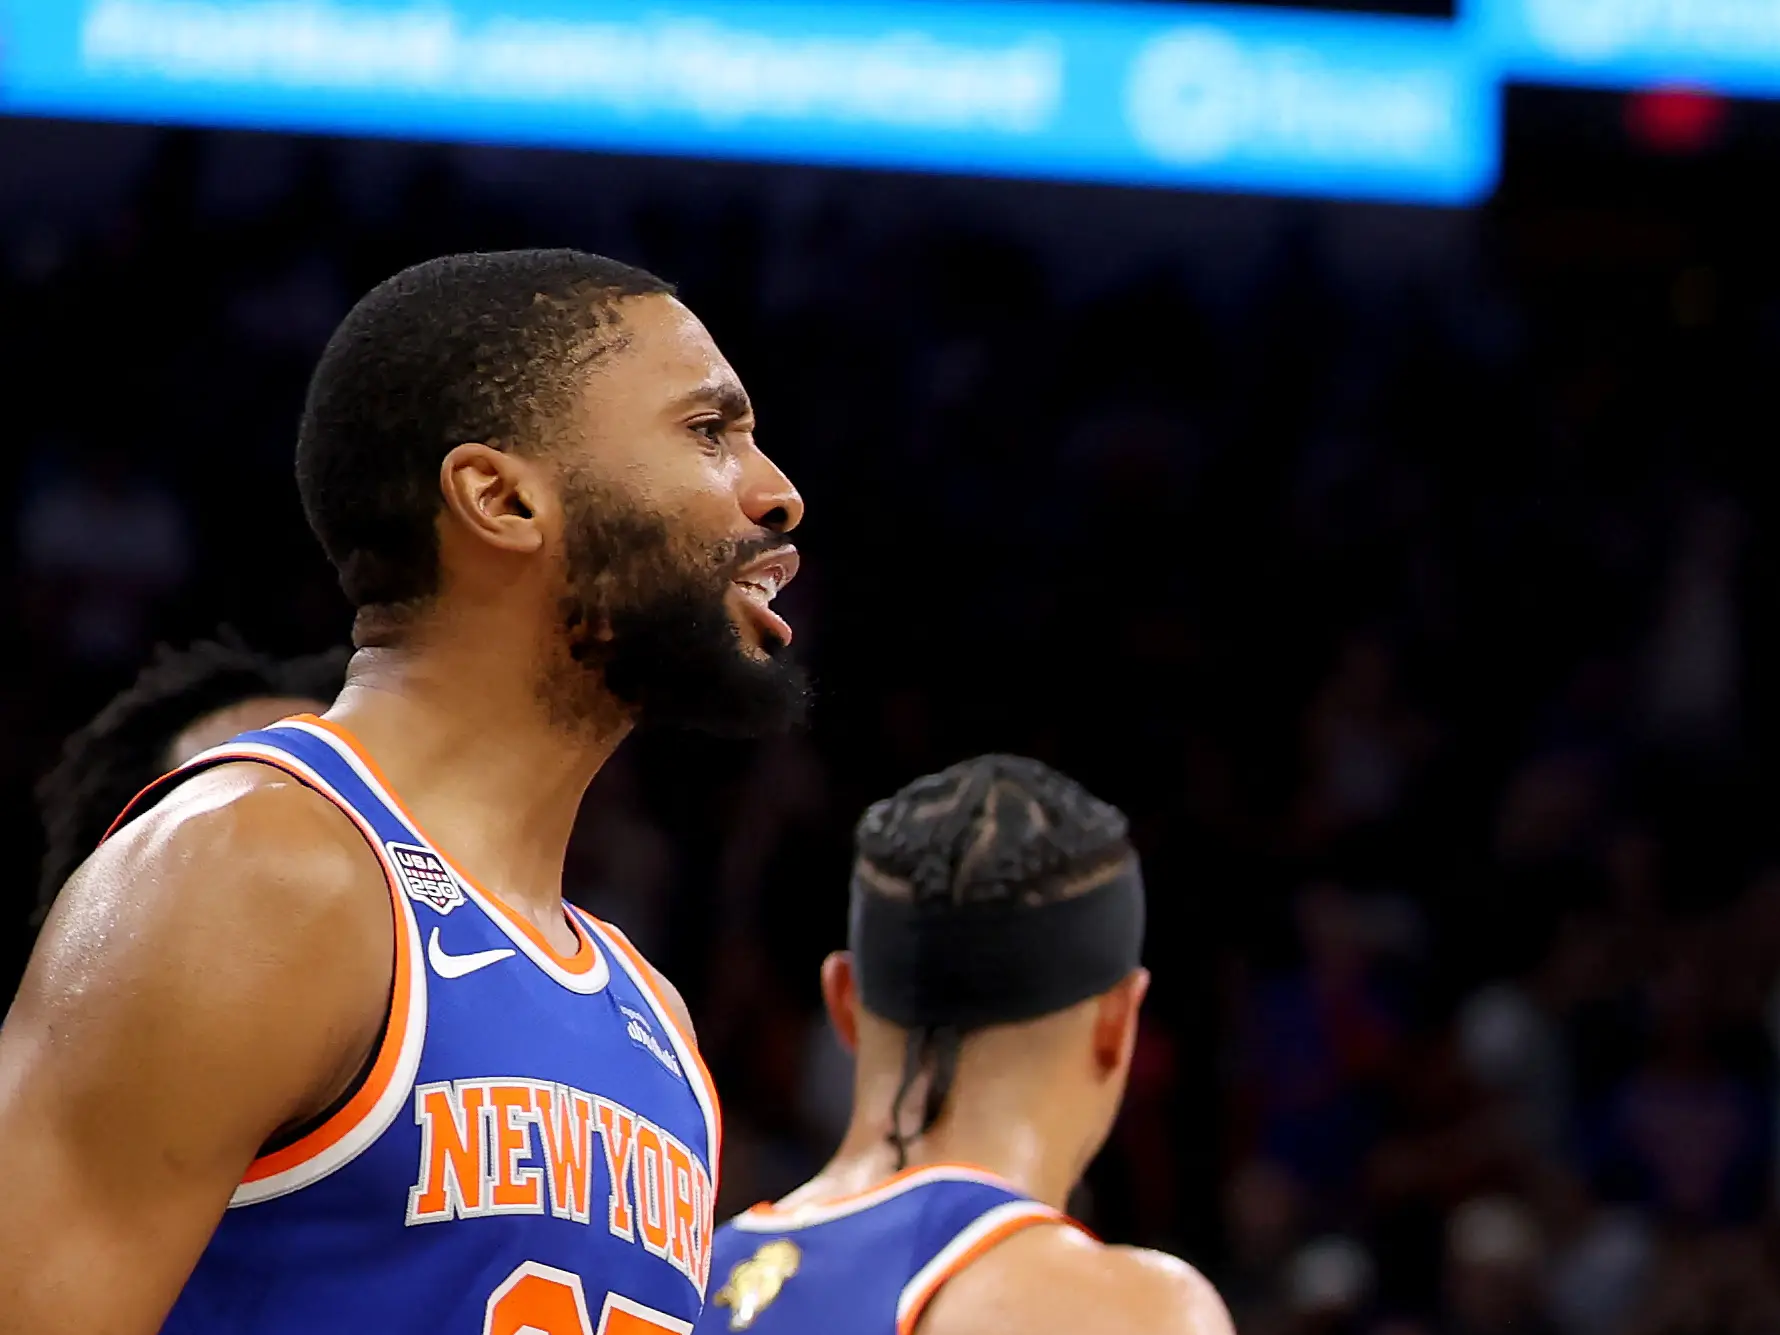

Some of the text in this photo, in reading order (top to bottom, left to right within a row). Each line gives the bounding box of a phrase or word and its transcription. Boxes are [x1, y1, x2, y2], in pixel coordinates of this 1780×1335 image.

[396, 851, 444, 872] USA
[408, 876, 459, 899] 250
[405, 1077, 591, 1227] NEW
